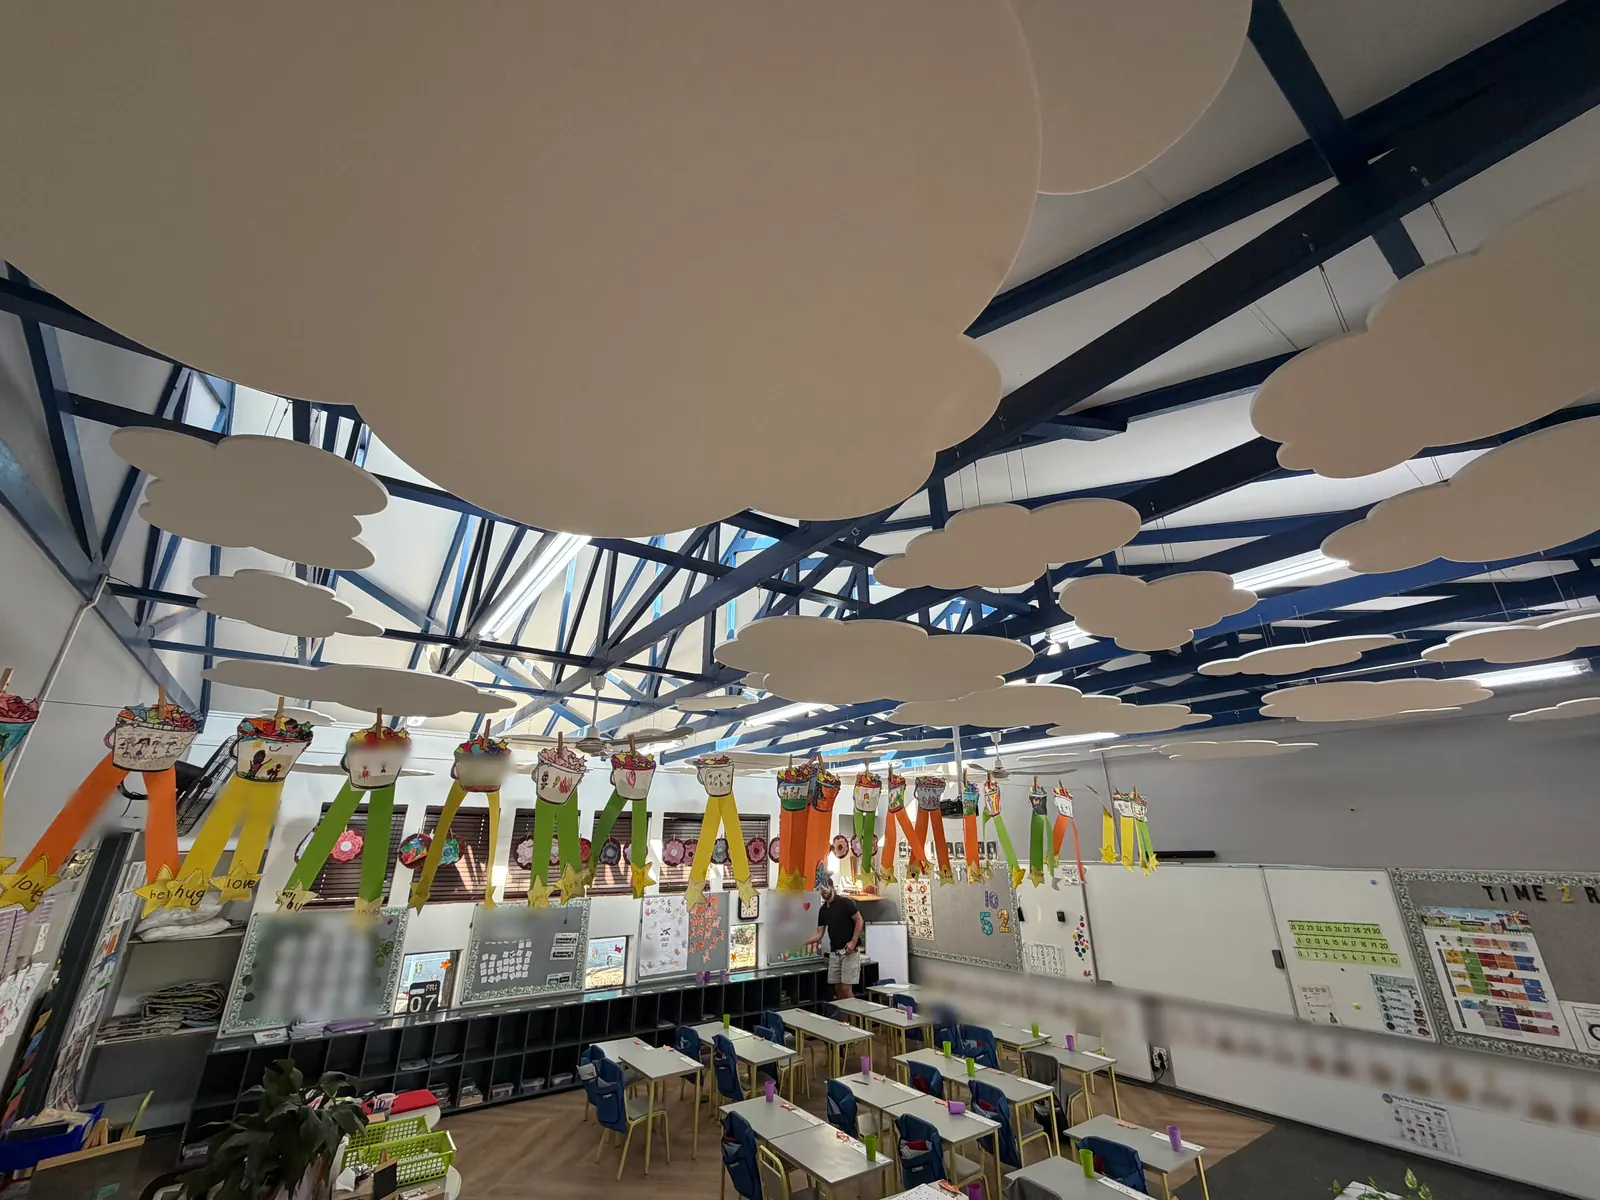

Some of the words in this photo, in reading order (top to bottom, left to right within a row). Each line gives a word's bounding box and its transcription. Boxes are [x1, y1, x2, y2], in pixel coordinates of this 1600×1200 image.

[12, 875, 44, 902] love
[227, 879, 256, 889] love
[150, 889, 172, 899] hel
[175, 885, 206, 906] hug
[984, 890, 999, 909] 10
[1482, 885, 1548, 902] TIME
[1558, 886, 1574, 903] 2
[980, 911, 993, 935] 5
[997, 909, 1011, 933] 2
[409, 994, 438, 1013] 07
